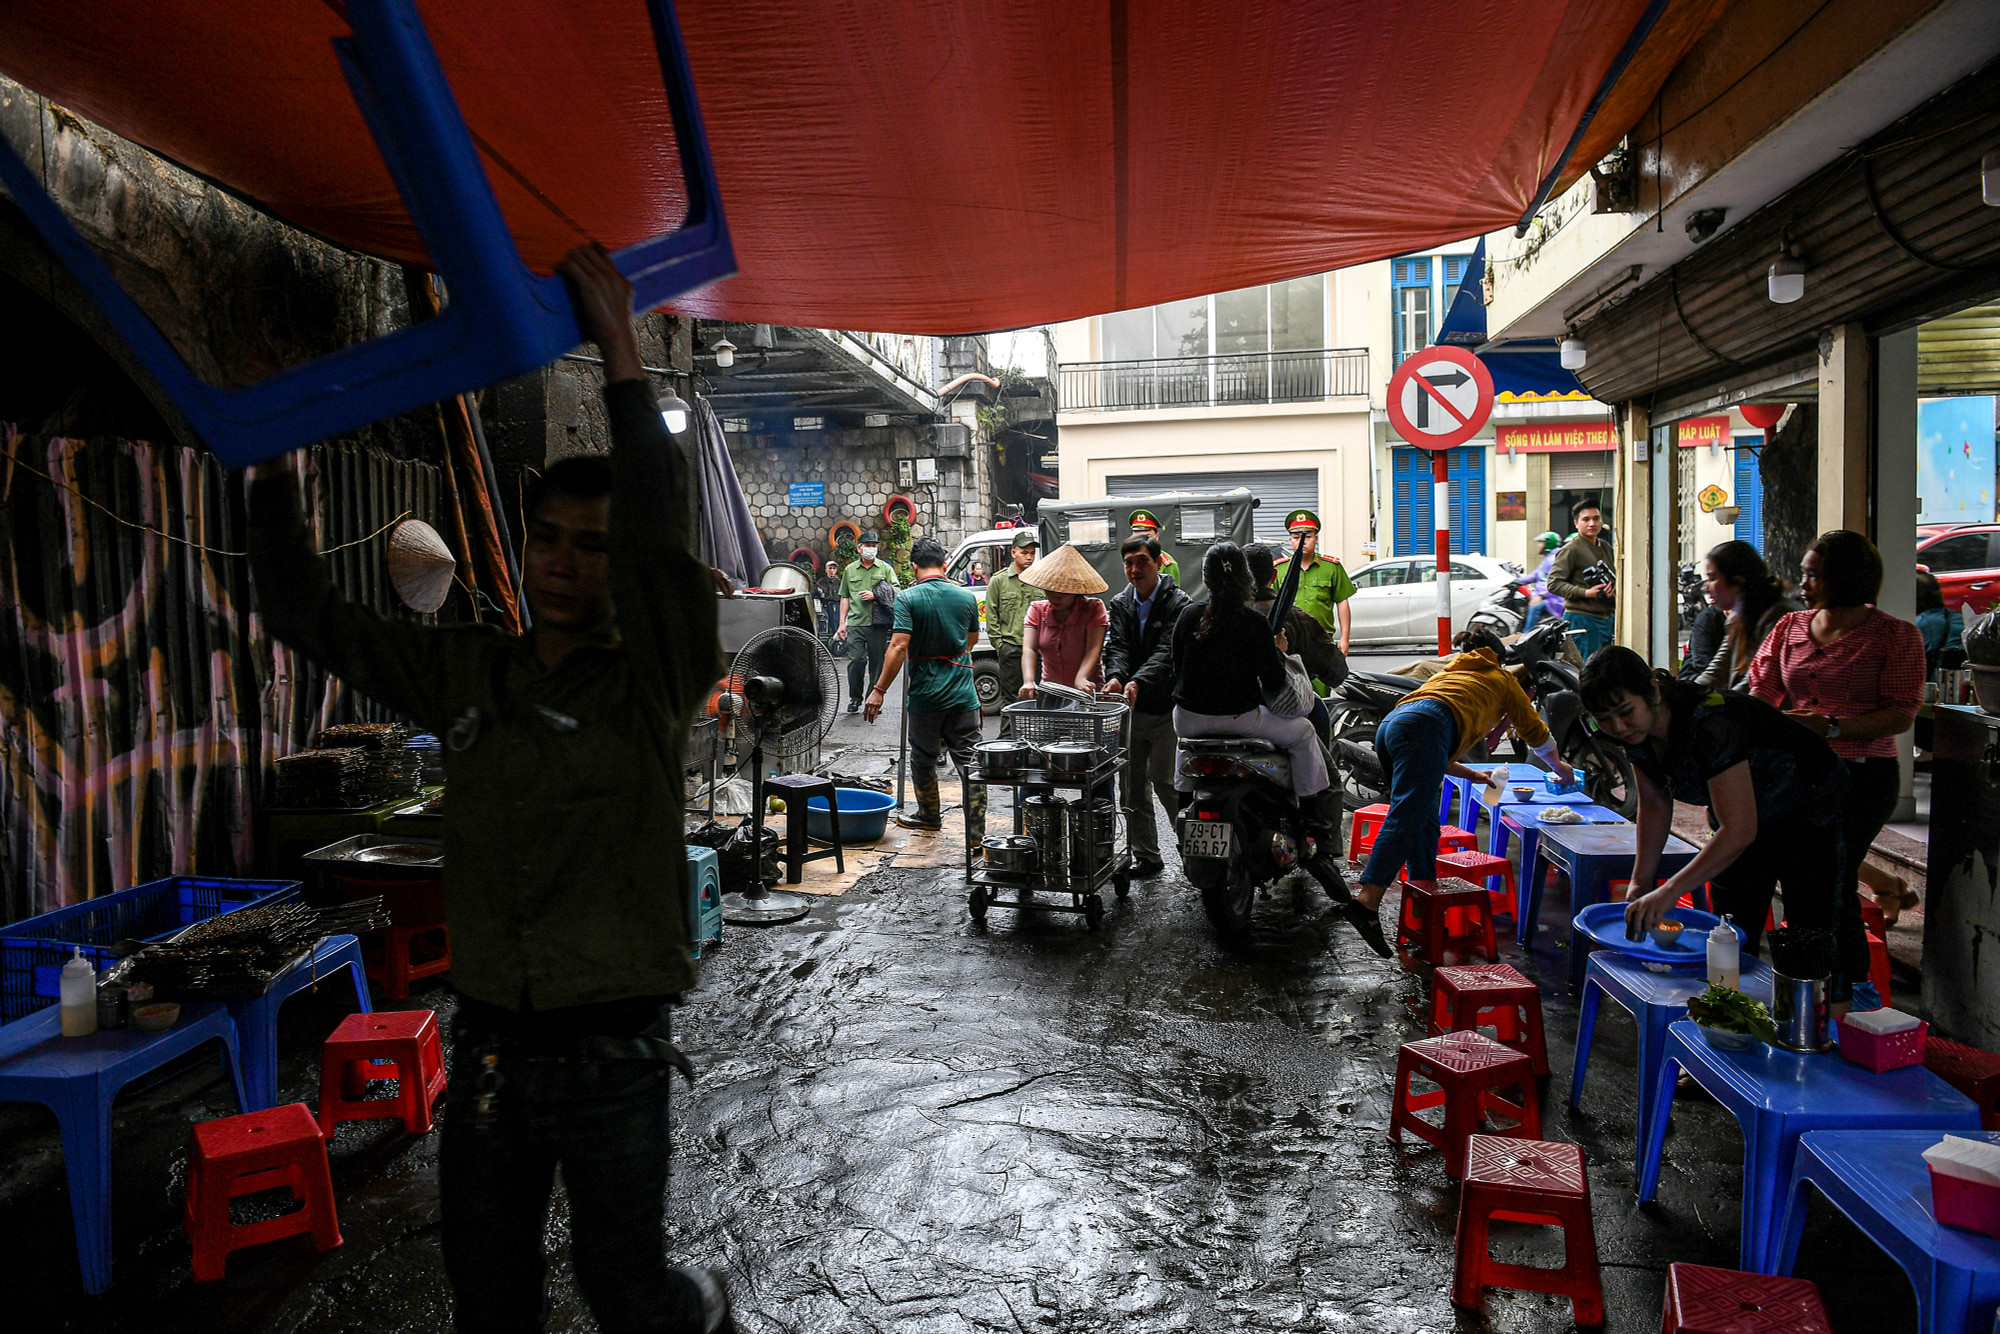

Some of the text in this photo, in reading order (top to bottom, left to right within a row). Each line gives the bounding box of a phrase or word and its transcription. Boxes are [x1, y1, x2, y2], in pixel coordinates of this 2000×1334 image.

[1505, 430, 1528, 448] SỐNG
[1530, 430, 1542, 446] VÀ
[1544, 430, 1562, 446] LÀM
[1564, 429, 1584, 448] VIỆC
[1586, 431, 1608, 444] THEO
[1679, 424, 1697, 440] HÁP
[1190, 823, 1224, 840] 29-C1
[1185, 840, 1228, 856] 563.67
